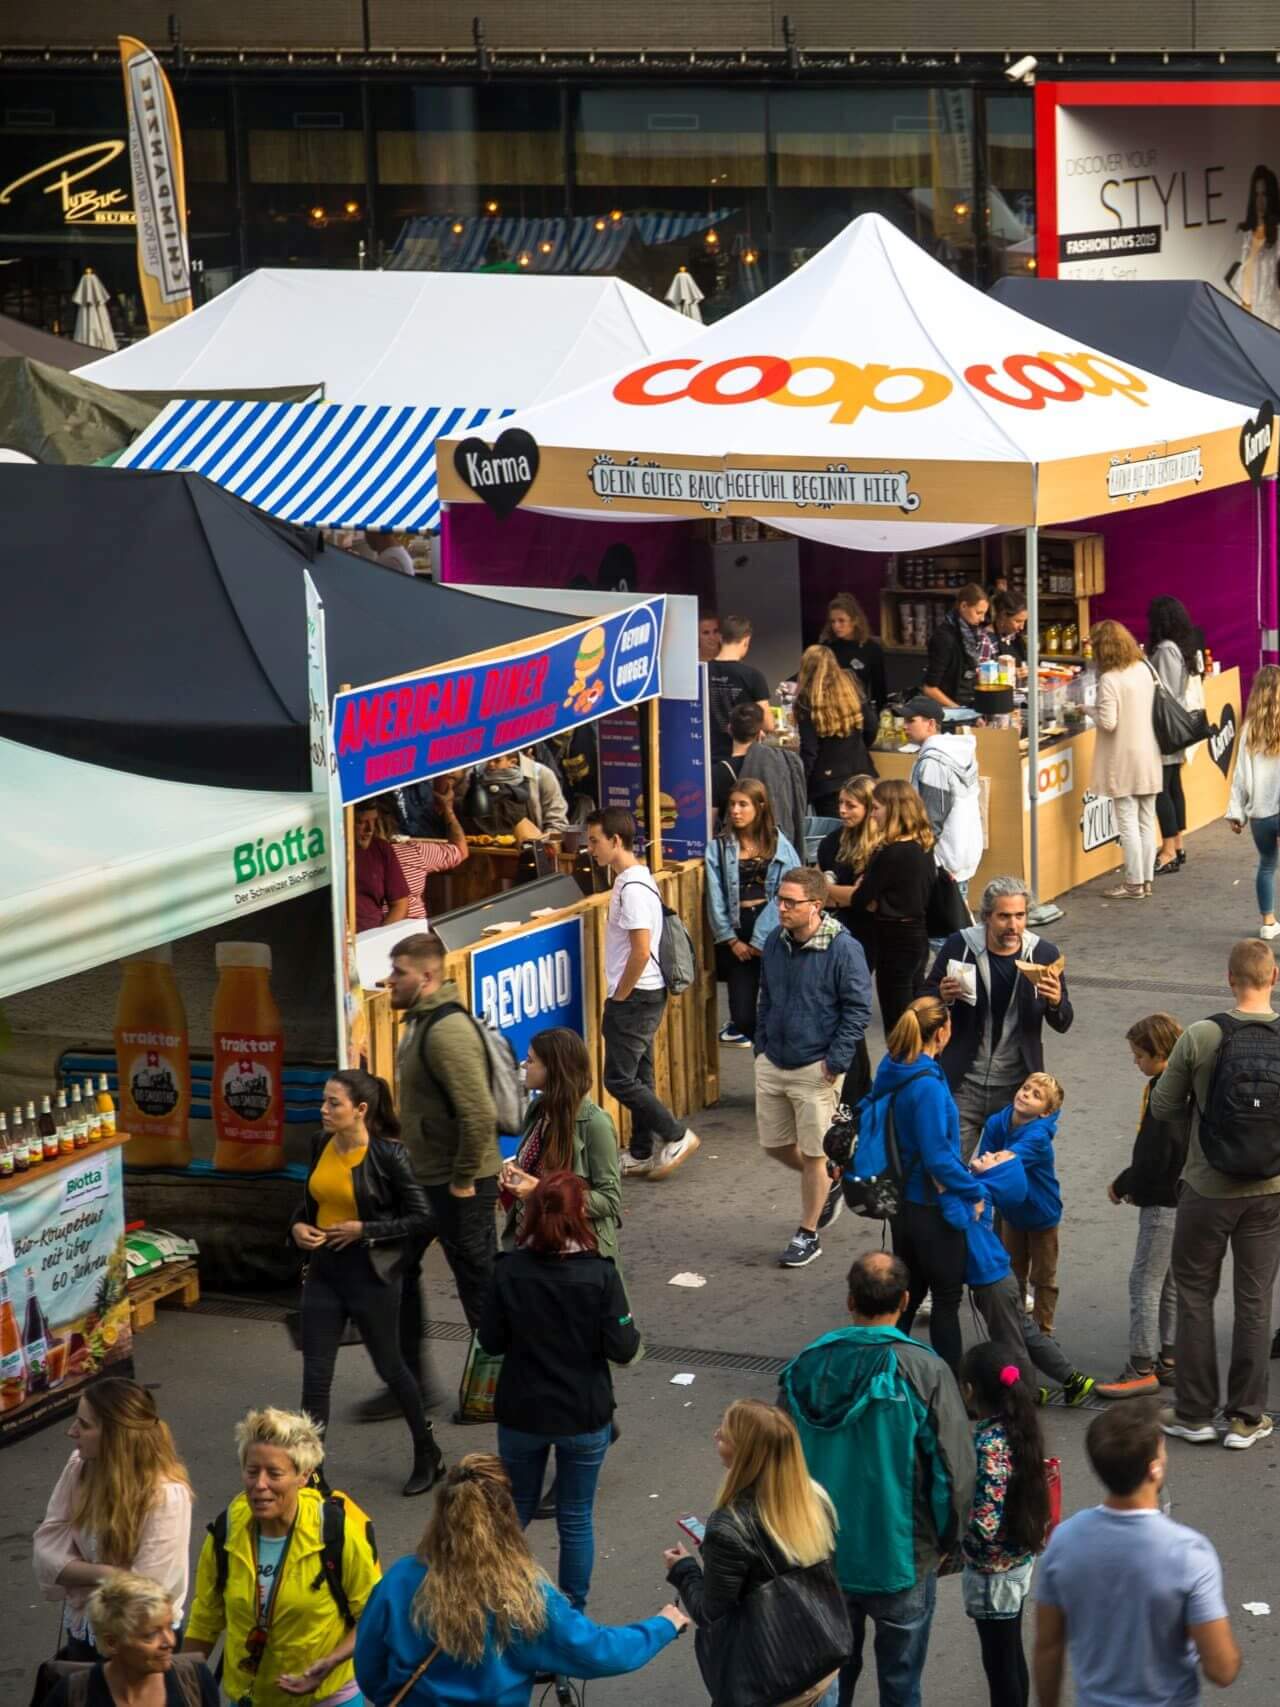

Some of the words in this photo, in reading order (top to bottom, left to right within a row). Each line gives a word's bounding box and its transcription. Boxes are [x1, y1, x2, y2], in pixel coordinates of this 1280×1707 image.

[1066, 153, 1122, 177] DISCOVER
[1127, 150, 1159, 170] YOUR
[1100, 166, 1228, 231] STYLE
[1065, 236, 1110, 255] FASHION
[1110, 234, 1135, 250] DAYS
[1135, 232, 1158, 249] 2019
[612, 355, 954, 425] coop
[964, 351, 1150, 410] coop
[1245, 424, 1271, 466] Karma
[465, 452, 532, 488] Karma
[599, 468, 636, 495] DEIN
[641, 471, 683, 497] GUTES
[688, 471, 788, 501] BAUCHGEFÜHL
[793, 474, 857, 502] BEGINNT
[863, 477, 901, 503] HIER
[620, 622, 651, 653] BEYOND
[616, 659, 650, 688] BURGER
[338, 674, 475, 757] AMERICAN
[479, 655, 550, 721] DINER
[1210, 719, 1235, 762] Karma
[1038, 758, 1070, 793] oop
[1086, 798, 1114, 846] YOUR
[234, 826, 326, 885] Biotta
[234, 893, 249, 905] Der
[481, 949, 574, 1031] BEYOND
[122, 1031, 181, 1049] traktor
[220, 1036, 277, 1053] traktor
[66, 1169, 103, 1194] Biotta
[41, 1247, 63, 1271] seit
[65, 1238, 93, 1260] über
[52, 1271, 68, 1292] 60
[71, 1254, 108, 1284] Jahren
